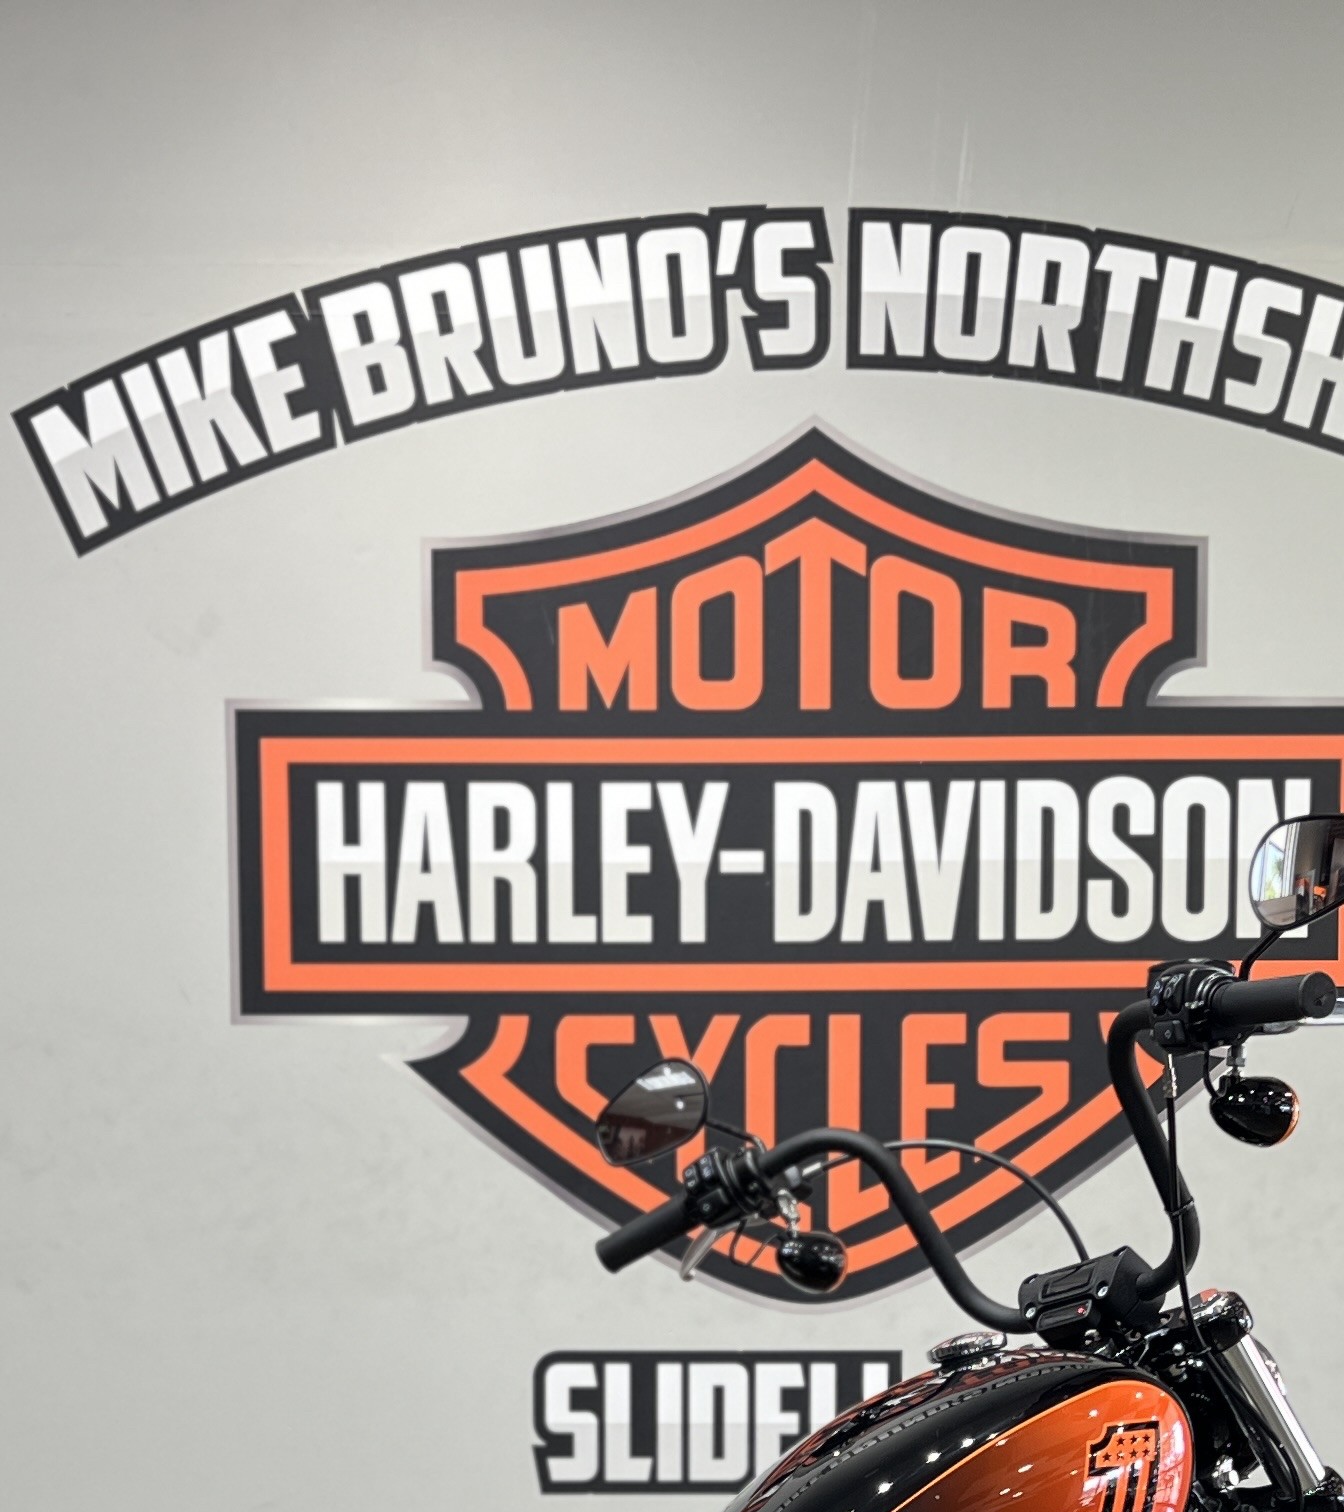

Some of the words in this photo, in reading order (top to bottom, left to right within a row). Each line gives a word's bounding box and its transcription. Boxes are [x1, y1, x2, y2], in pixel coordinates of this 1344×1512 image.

[31, 310, 322, 538] MIKE
[320, 219, 817, 427] BRUNO'S
[558, 517, 1078, 711] MOTOR
[317, 775, 1311, 944] HARLEY-DAVIDSON
[543, 1362, 889, 1482] SLIDE
